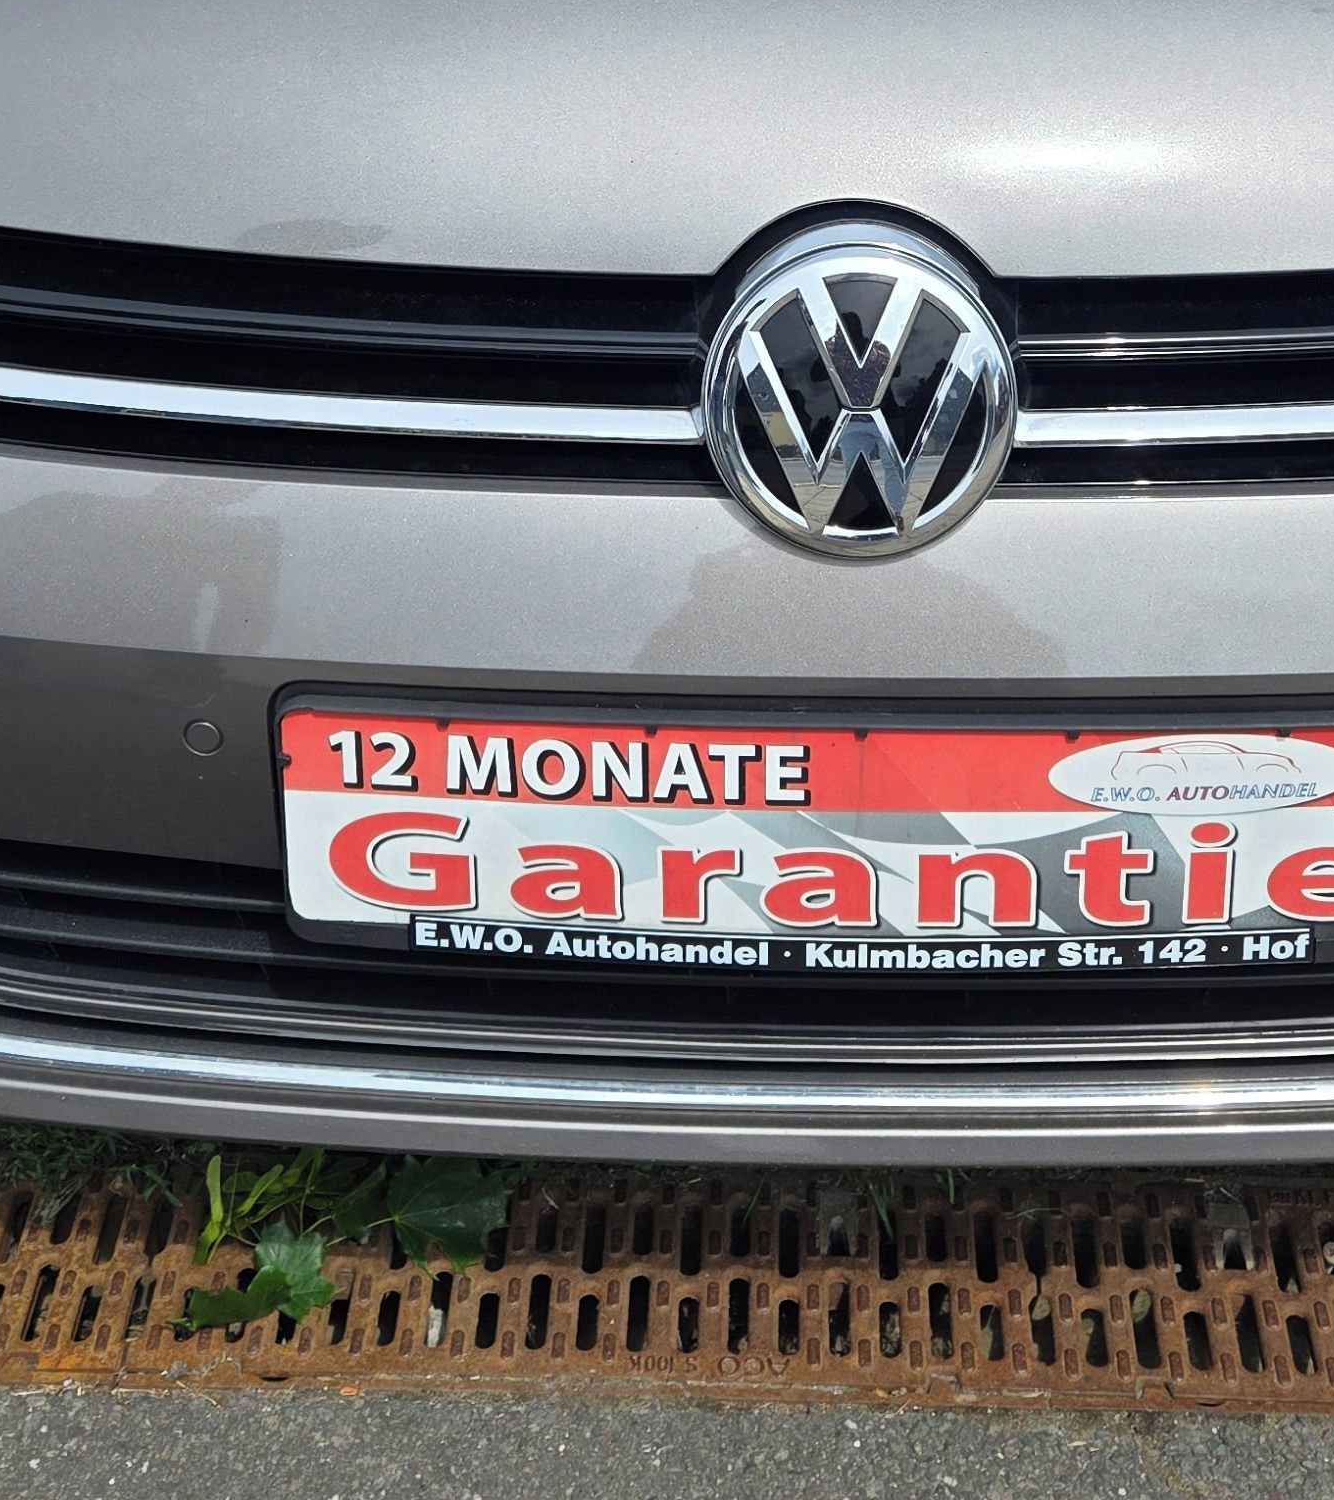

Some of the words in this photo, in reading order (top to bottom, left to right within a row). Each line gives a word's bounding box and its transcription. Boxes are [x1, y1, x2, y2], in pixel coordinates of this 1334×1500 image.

[328, 730, 418, 792] 12
[447, 733, 810, 806] MONATE
[1091, 786, 1161, 802] E.W.O.
[1167, 782, 1318, 802] AUTOHANDEL
[414, 922, 534, 955] E.W.O.
[545, 931, 769, 967] Autohandel
[805, 942, 1046, 970] Kulmbacher
[1057, 941, 1123, 967] Str.
[1137, 939, 1207, 964] 142
[1242, 933, 1310, 962] Hof
[628, 1355, 674, 1373] 100K
[717, 1356, 791, 1378] ACO
